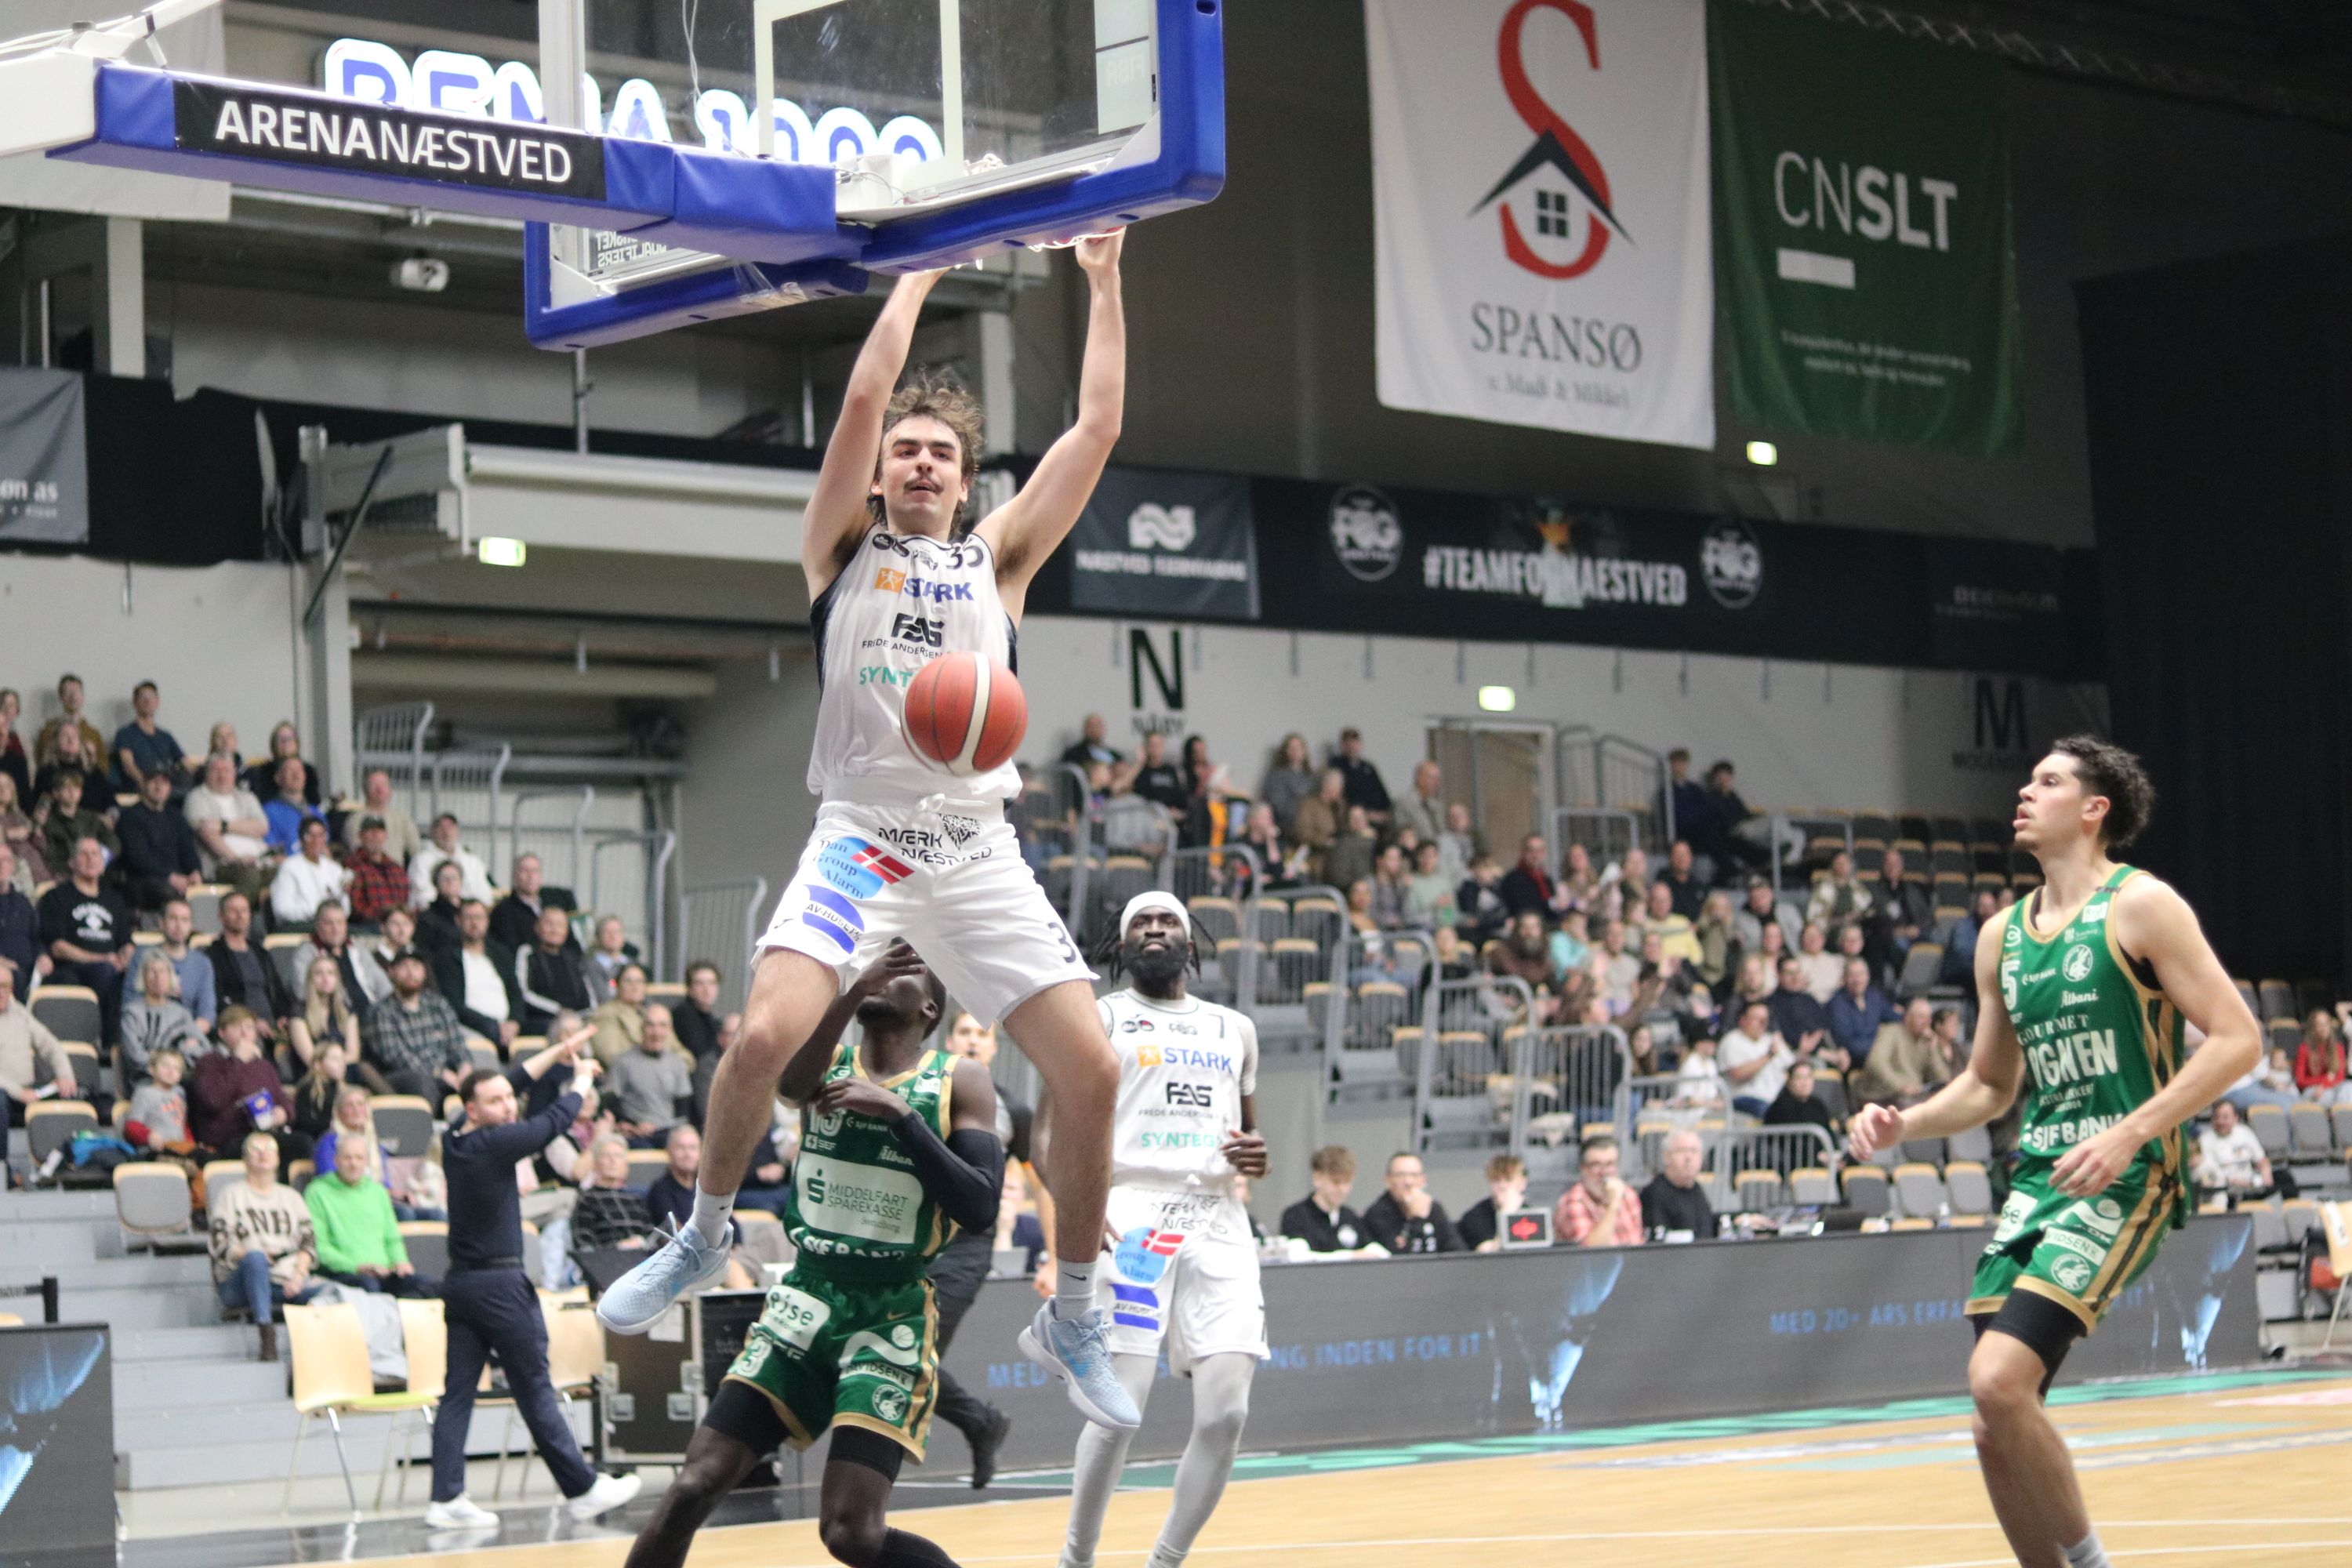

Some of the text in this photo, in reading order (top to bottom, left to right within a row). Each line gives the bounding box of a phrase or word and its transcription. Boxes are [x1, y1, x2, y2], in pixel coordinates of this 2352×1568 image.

[216, 101, 572, 183] ARENANÆSTVED
[1774, 151, 1958, 252] CNSLT
[1471, 299, 1642, 374] SPANSØ
[903, 577, 975, 604] STARK
[1130, 628, 1185, 711] N
[823, 868, 864, 900] Alarm
[1164, 1047, 1233, 1075] STARK
[2031, 1123, 2060, 1152] SJF
[826, 1196, 904, 1221] SPAREKASSE
[828, 1182, 909, 1207] MIDDELFART
[988, 1362, 1047, 1389] MED
[1316, 1339, 1396, 1367] INDEN
[1405, 1334, 1452, 1359] FOR
[1460, 1331, 1481, 1356] IT
